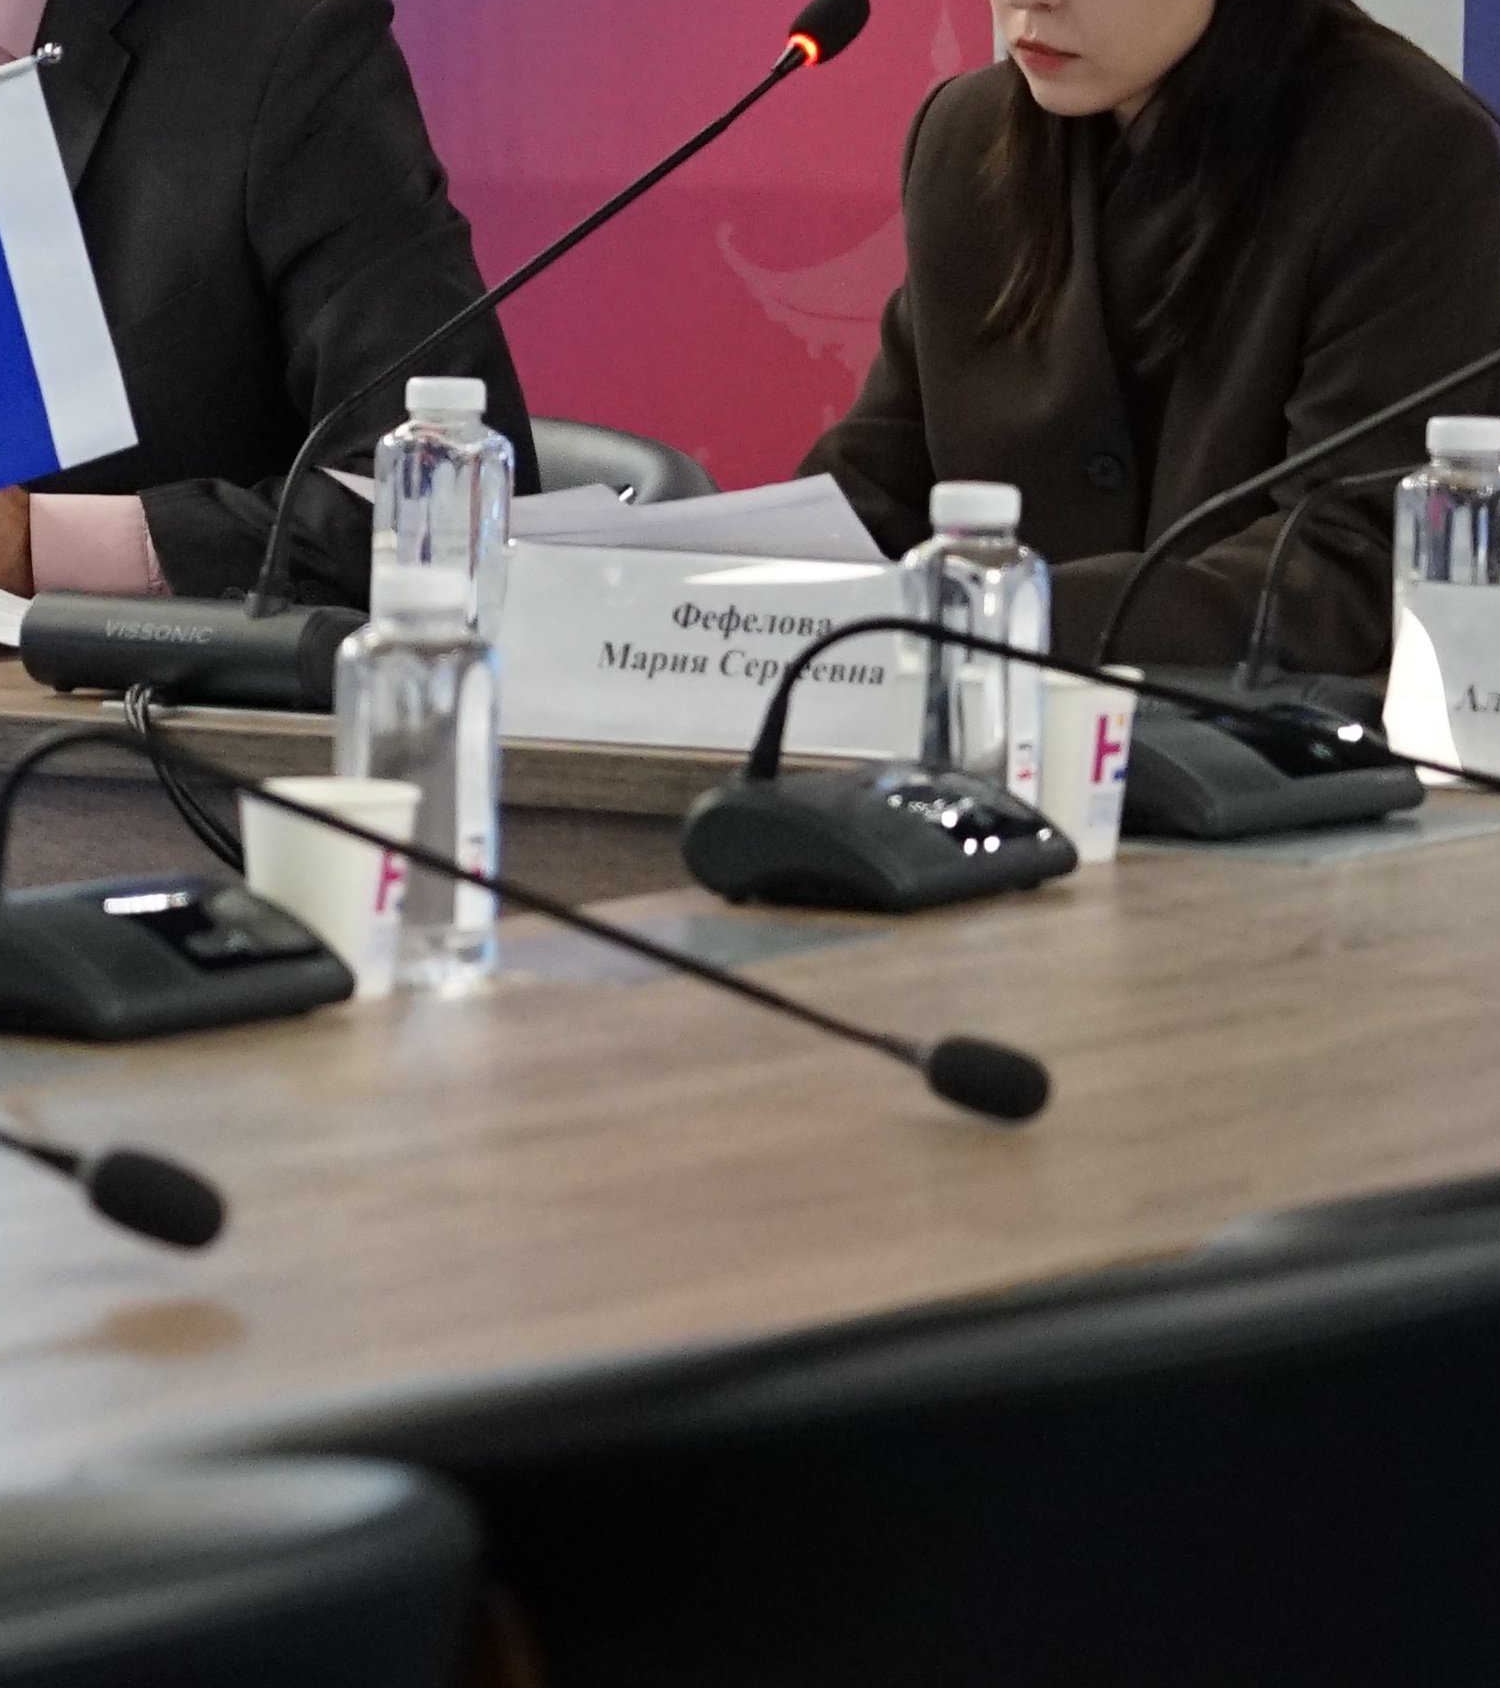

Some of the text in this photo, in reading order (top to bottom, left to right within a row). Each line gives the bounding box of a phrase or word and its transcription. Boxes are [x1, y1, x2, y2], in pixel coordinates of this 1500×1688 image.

[106, 619, 213, 644] VISSONIC
[672, 602, 833, 640] Фефелова
[598, 641, 885, 687] Мария Серевна
